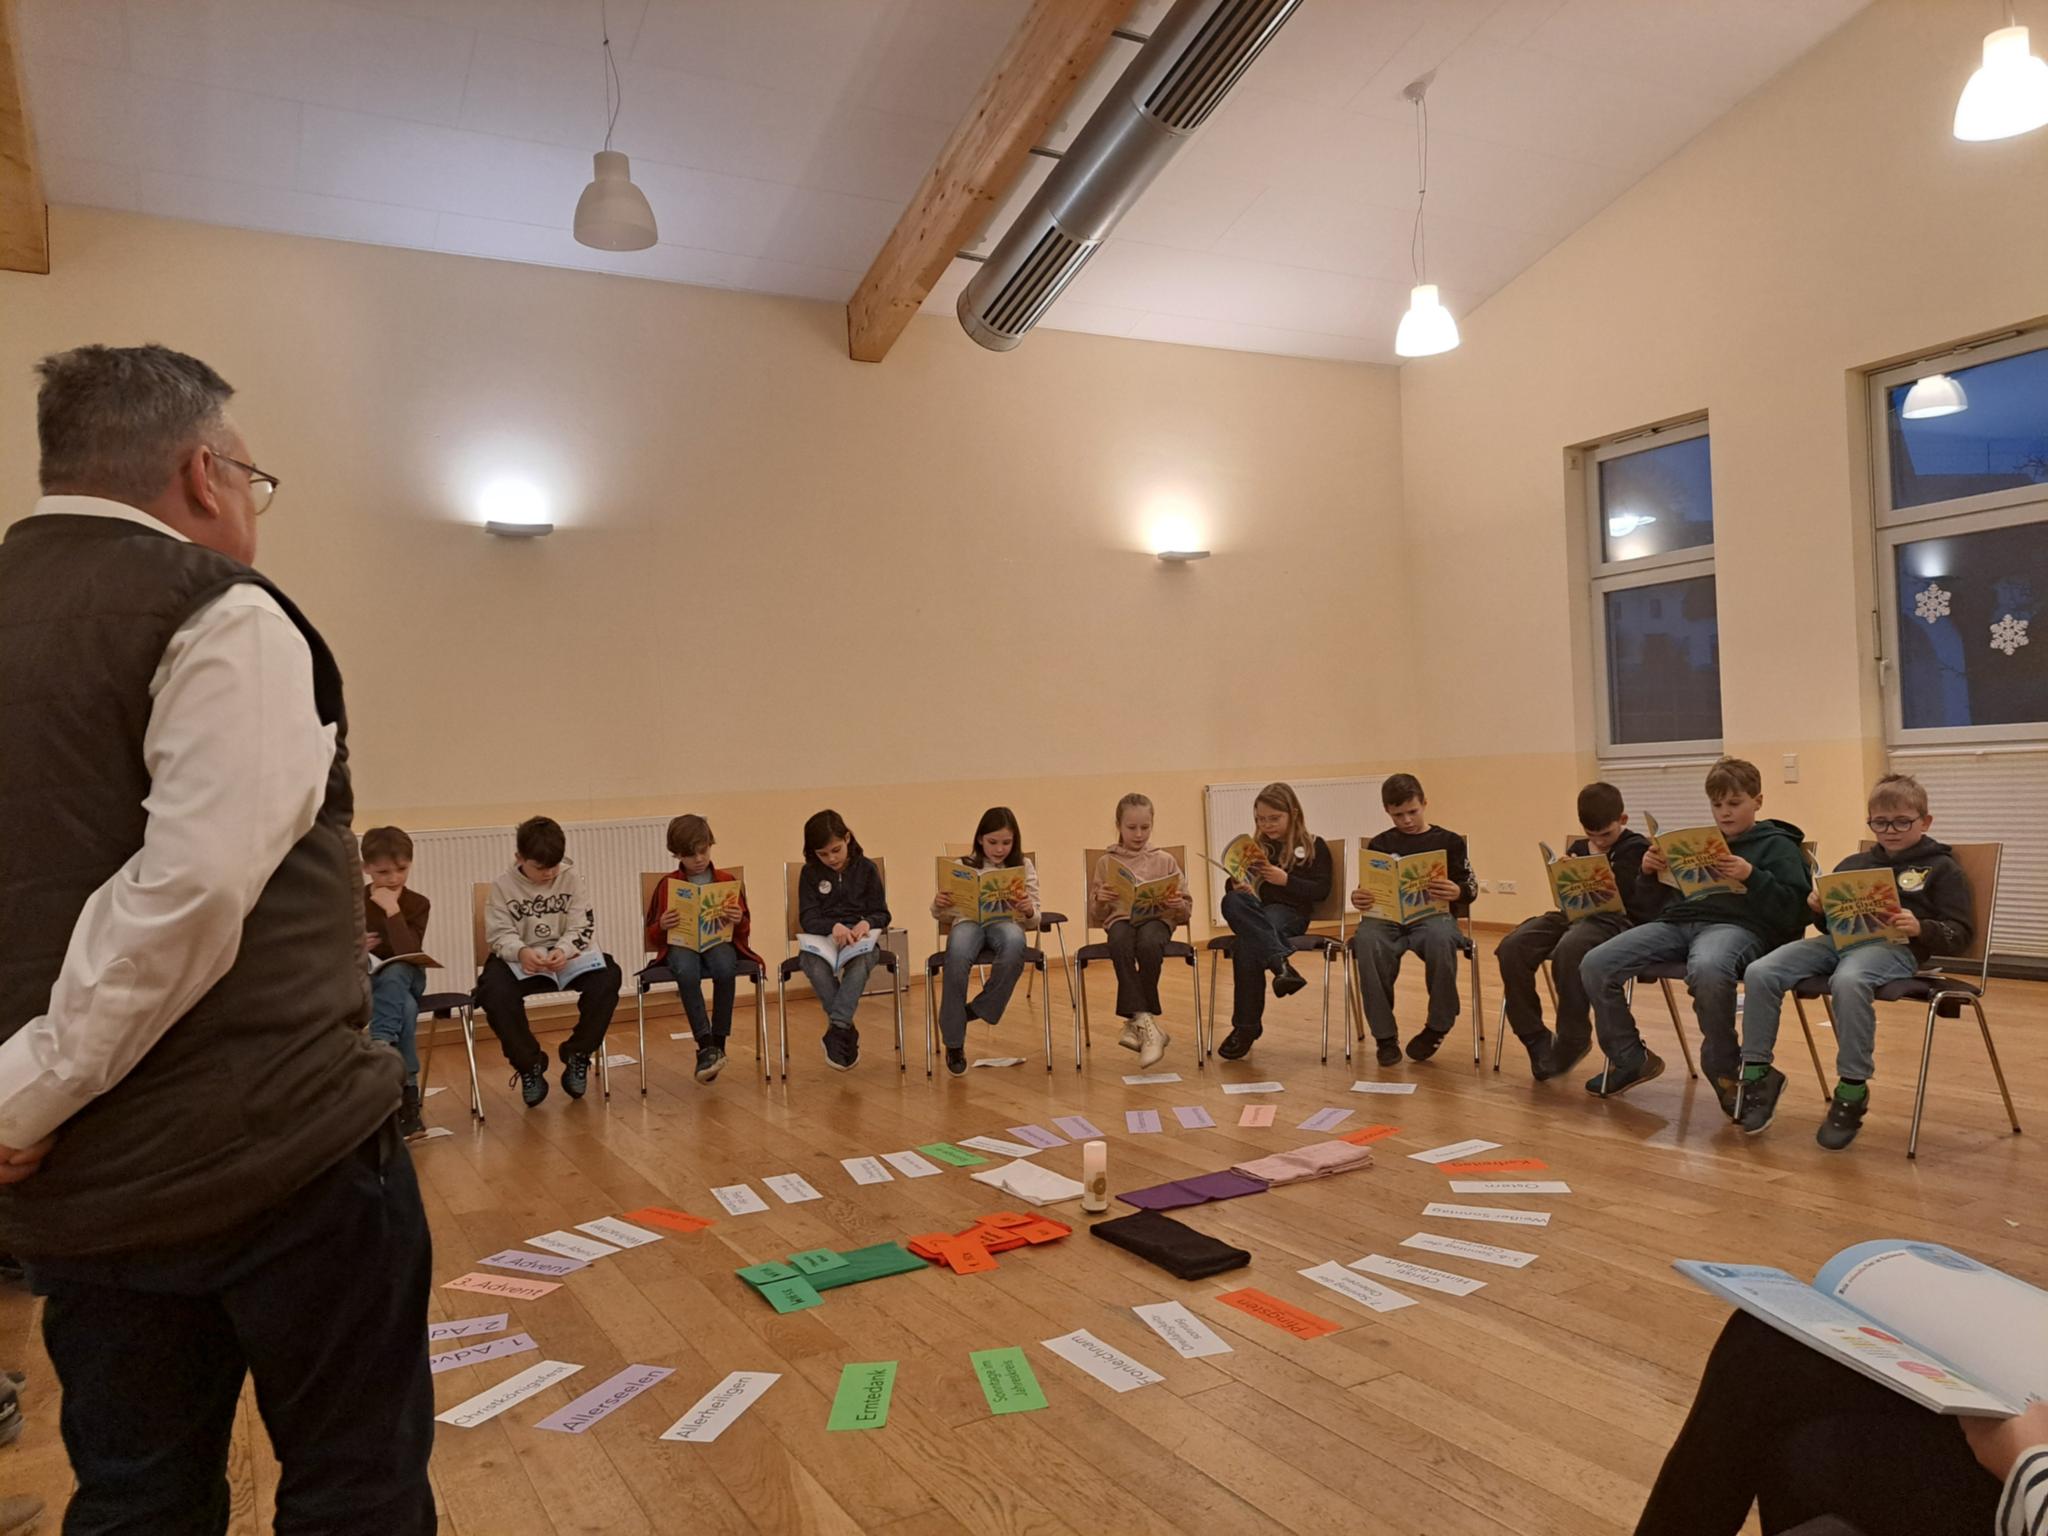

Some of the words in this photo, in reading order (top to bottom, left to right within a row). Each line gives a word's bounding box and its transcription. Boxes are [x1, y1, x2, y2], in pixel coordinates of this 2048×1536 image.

[507, 1255, 571, 1274] Advent
[1384, 1259, 1471, 1285] Himmelfahrt
[1396, 1268, 1440, 1284] Christi
[452, 1277, 468, 1287] 3.
[471, 1280, 545, 1297] Advent
[477, 1320, 499, 1330] 2.
[1237, 1299, 1308, 1333] Pfingsten
[431, 1326, 469, 1339] Ad
[499, 1338, 523, 1347] 1.
[1071, 1334, 1150, 1387] Fronleichnam
[453, 1365, 571, 1426] Christkönigsfest
[562, 1369, 665, 1431] Allerseelen
[676, 1375, 753, 1439] Allerheiligen
[856, 1368, 888, 1422] Erntedank
